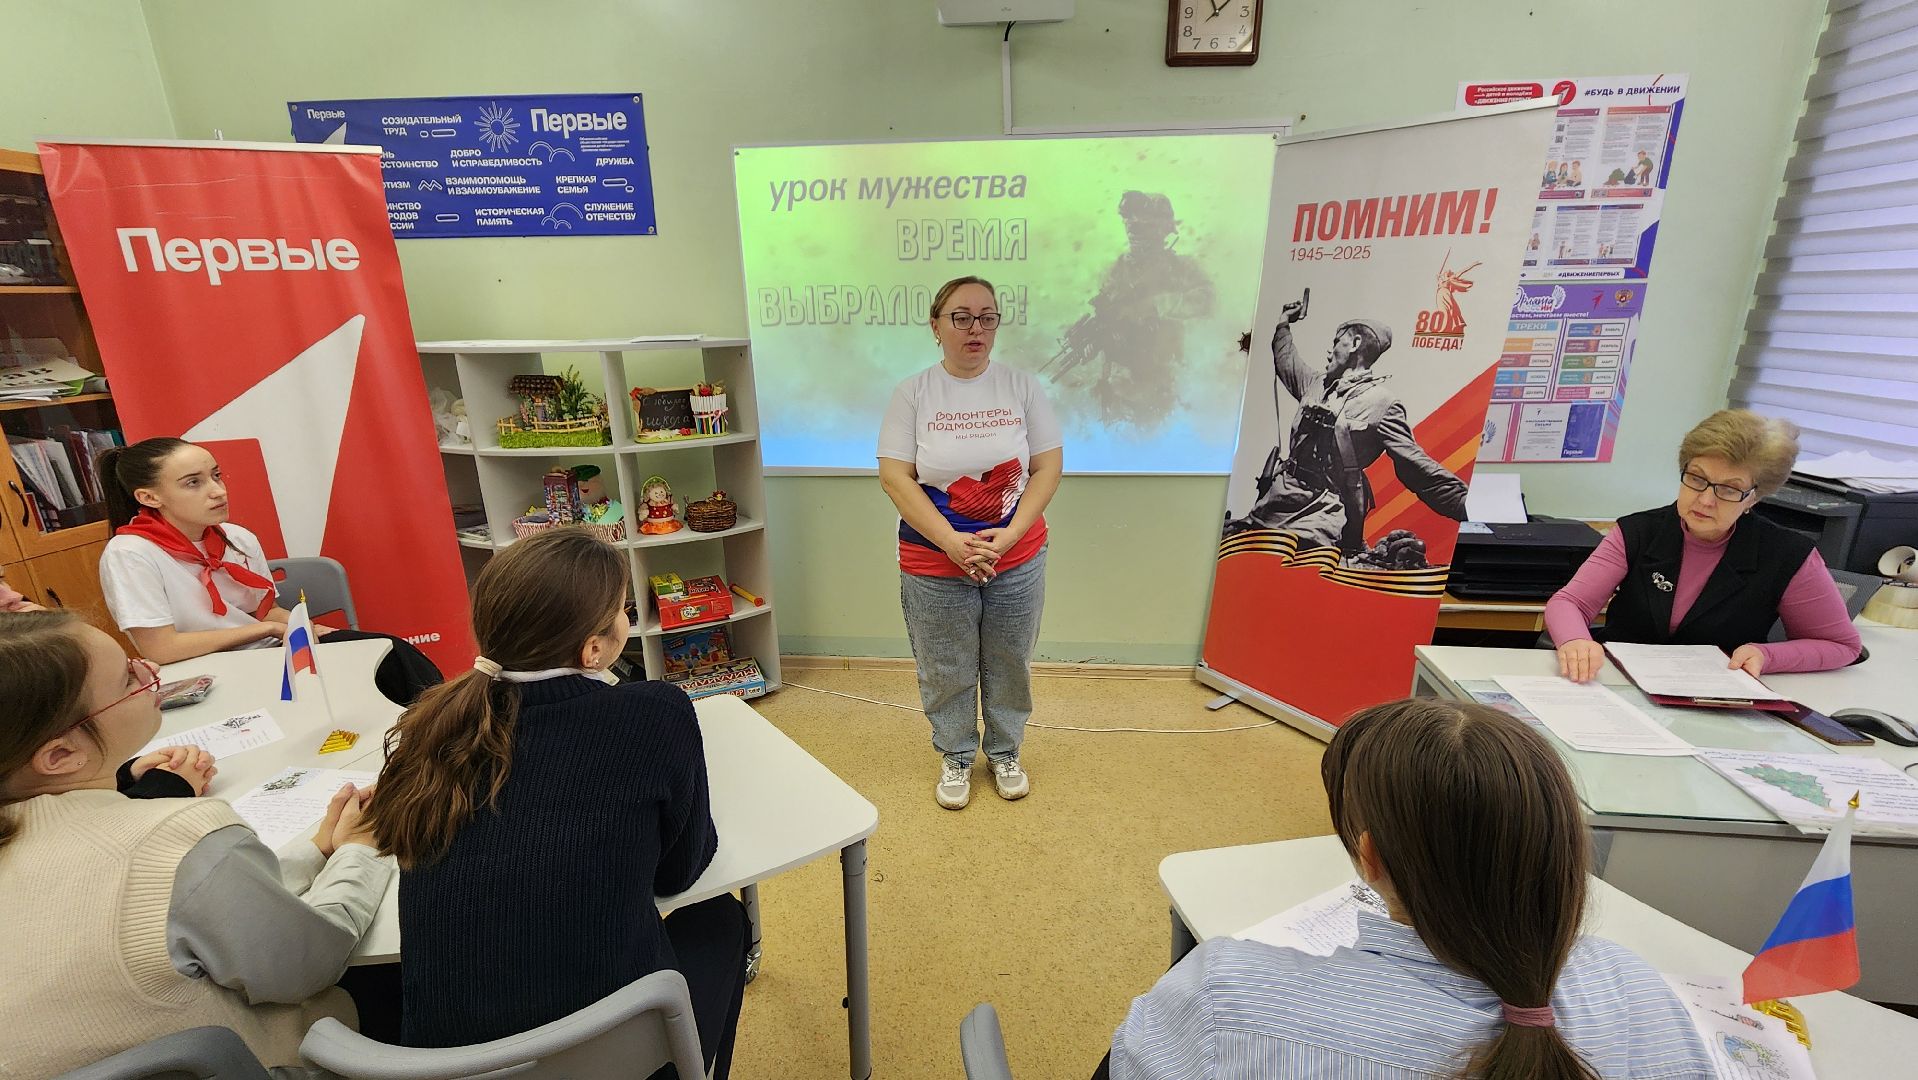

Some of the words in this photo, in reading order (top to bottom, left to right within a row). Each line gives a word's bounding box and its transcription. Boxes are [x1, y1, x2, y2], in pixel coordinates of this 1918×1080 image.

[1184, 7, 1194, 19] 9
[1240, 6, 1249, 18] 3
[1183, 26, 1193, 37] 8
[1192, 38, 1202, 49] 7
[1210, 37, 1219, 49] 6
[1228, 37, 1238, 49] 5
[1584, 88, 1614, 96] #БУДЬ
[1626, 85, 1681, 96] ДВИЖЕНИИ
[307, 109, 346, 122] Первые
[381, 114, 462, 126] СОЗИДАТЕЛЬНЫЙ
[530, 108, 627, 139] Первые
[383, 127, 408, 136] ТРУД
[450, 149, 482, 158] ДОБРО
[380, 160, 439, 169] ОСТОИНСТВО
[452, 159, 459, 167] И
[459, 158, 543, 168] СПРАВЕДЛИВОСТЬ
[596, 157, 635, 167] ДРУЖБА
[445, 176, 526, 186] ВЗАИМОПОМОЩЬ
[555, 175, 597, 184] КРЕПКАЯ
[447, 187, 455, 196] И
[455, 186, 541, 196] ВЗАИМОУВАЖЕНИЕ
[557, 185, 589, 194] СЕМЬЯ
[769, 178, 848, 212] урок
[857, 174, 1028, 209] мужества
[386, 202, 422, 212] ИНСТВО
[475, 207, 545, 217] ИСТОРИЧЕСКАЯ
[584, 203, 634, 211] СЛУЖЕНИЕ
[388, 212, 419, 222] РОДОВ
[585, 212, 637, 221] ОТЕЧЕСТВУ
[1292, 187, 1499, 242] ПОМНИМ!
[389, 222, 415, 230] ССИИ
[476, 218, 513, 227] ПАМЯТЬ
[896, 217, 1028, 261] ВРЕМЯ
[116, 228, 361, 286] Первые
[1290, 245, 1372, 262] 1945–2025
[758, 284, 932, 328] ВЫБРАЛО
[999, 284, 1028, 326] С!
[1415, 310, 1445, 333] 80
[1514, 322, 1548, 330] ТРЕКИ
[1411, 336, 1464, 351] ПОБЕДА!
[935, 408, 1012, 421] ВОЛОНТЕРЫ
[927, 417, 1022, 433] ПОДМОСКОВЬЯ
[402, 632, 441, 645] ние
